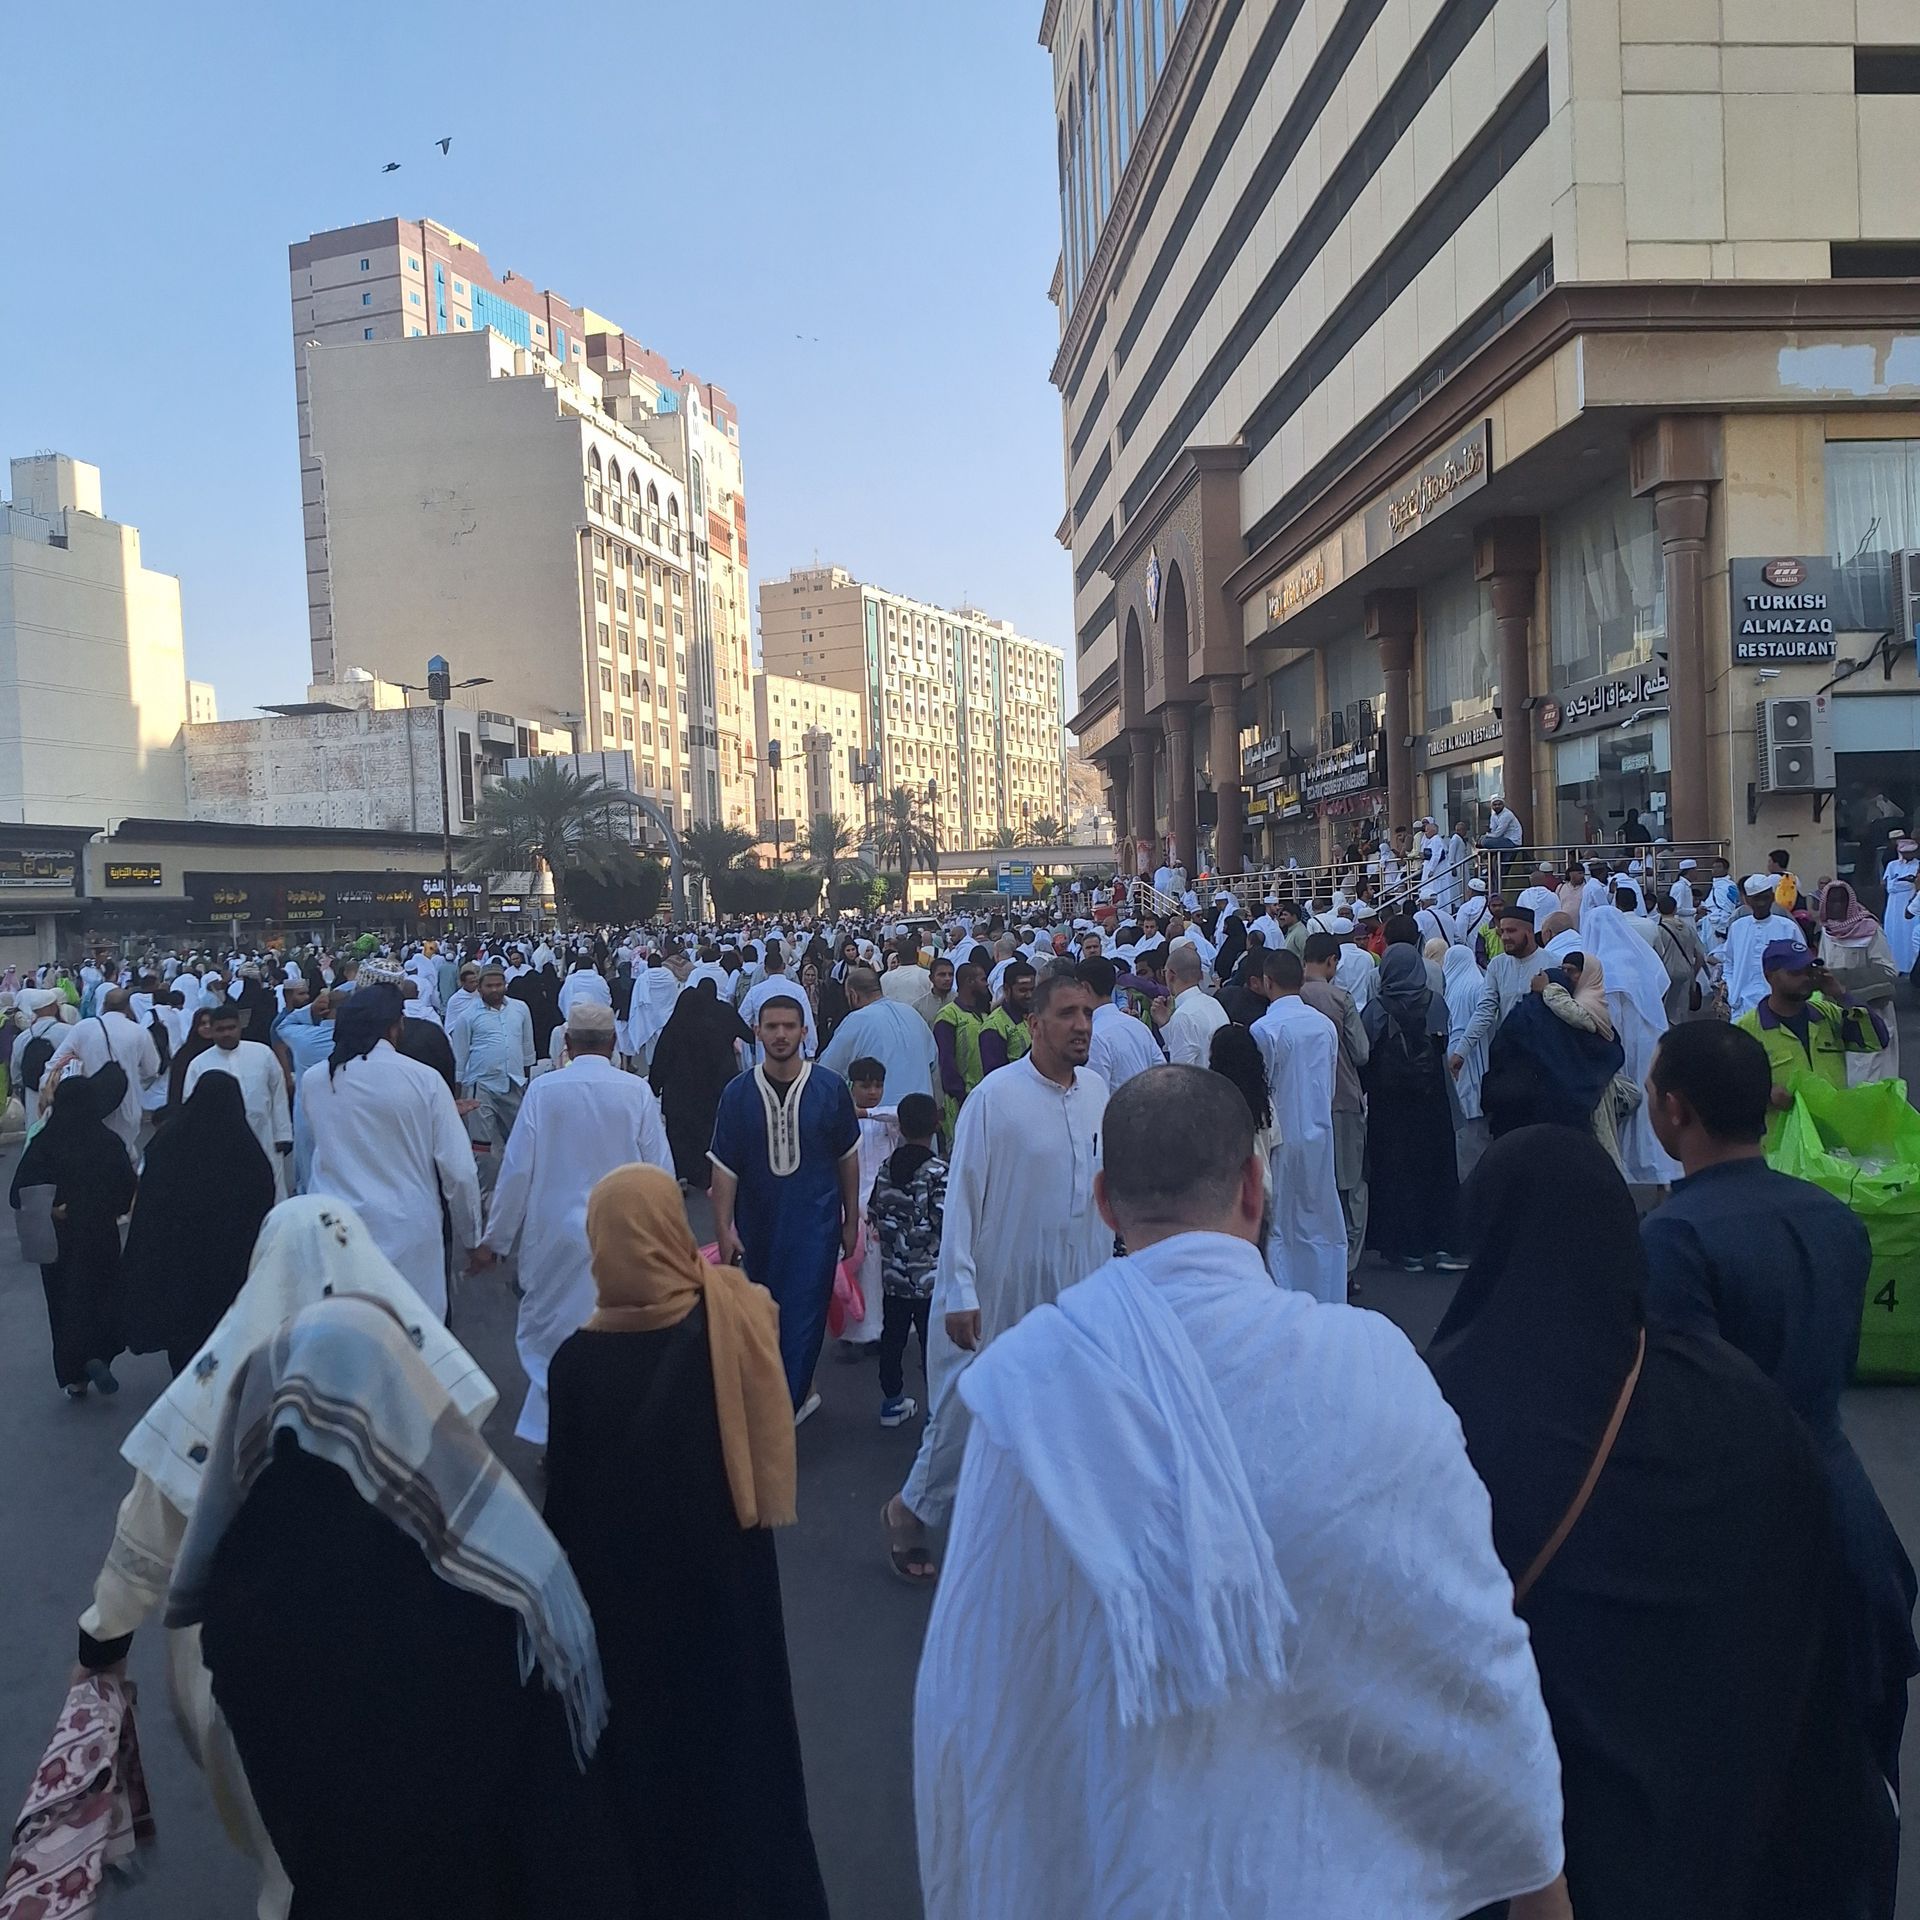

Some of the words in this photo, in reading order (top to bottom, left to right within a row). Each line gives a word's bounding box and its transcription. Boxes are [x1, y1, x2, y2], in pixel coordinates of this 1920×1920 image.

[1746, 594, 1828, 610] TURKISH
[1741, 618, 1833, 634] ALMAZAQ
[1737, 641, 1838, 658] RESTAURANT
[1605, 674, 1642, 709] المذاق
[1643, 667, 1670, 701] طعم
[1565, 685, 1605, 723] التركي
[1473, 720, 1503, 744] RESTAURAN
[1873, 1279, 1900, 1313] 4
